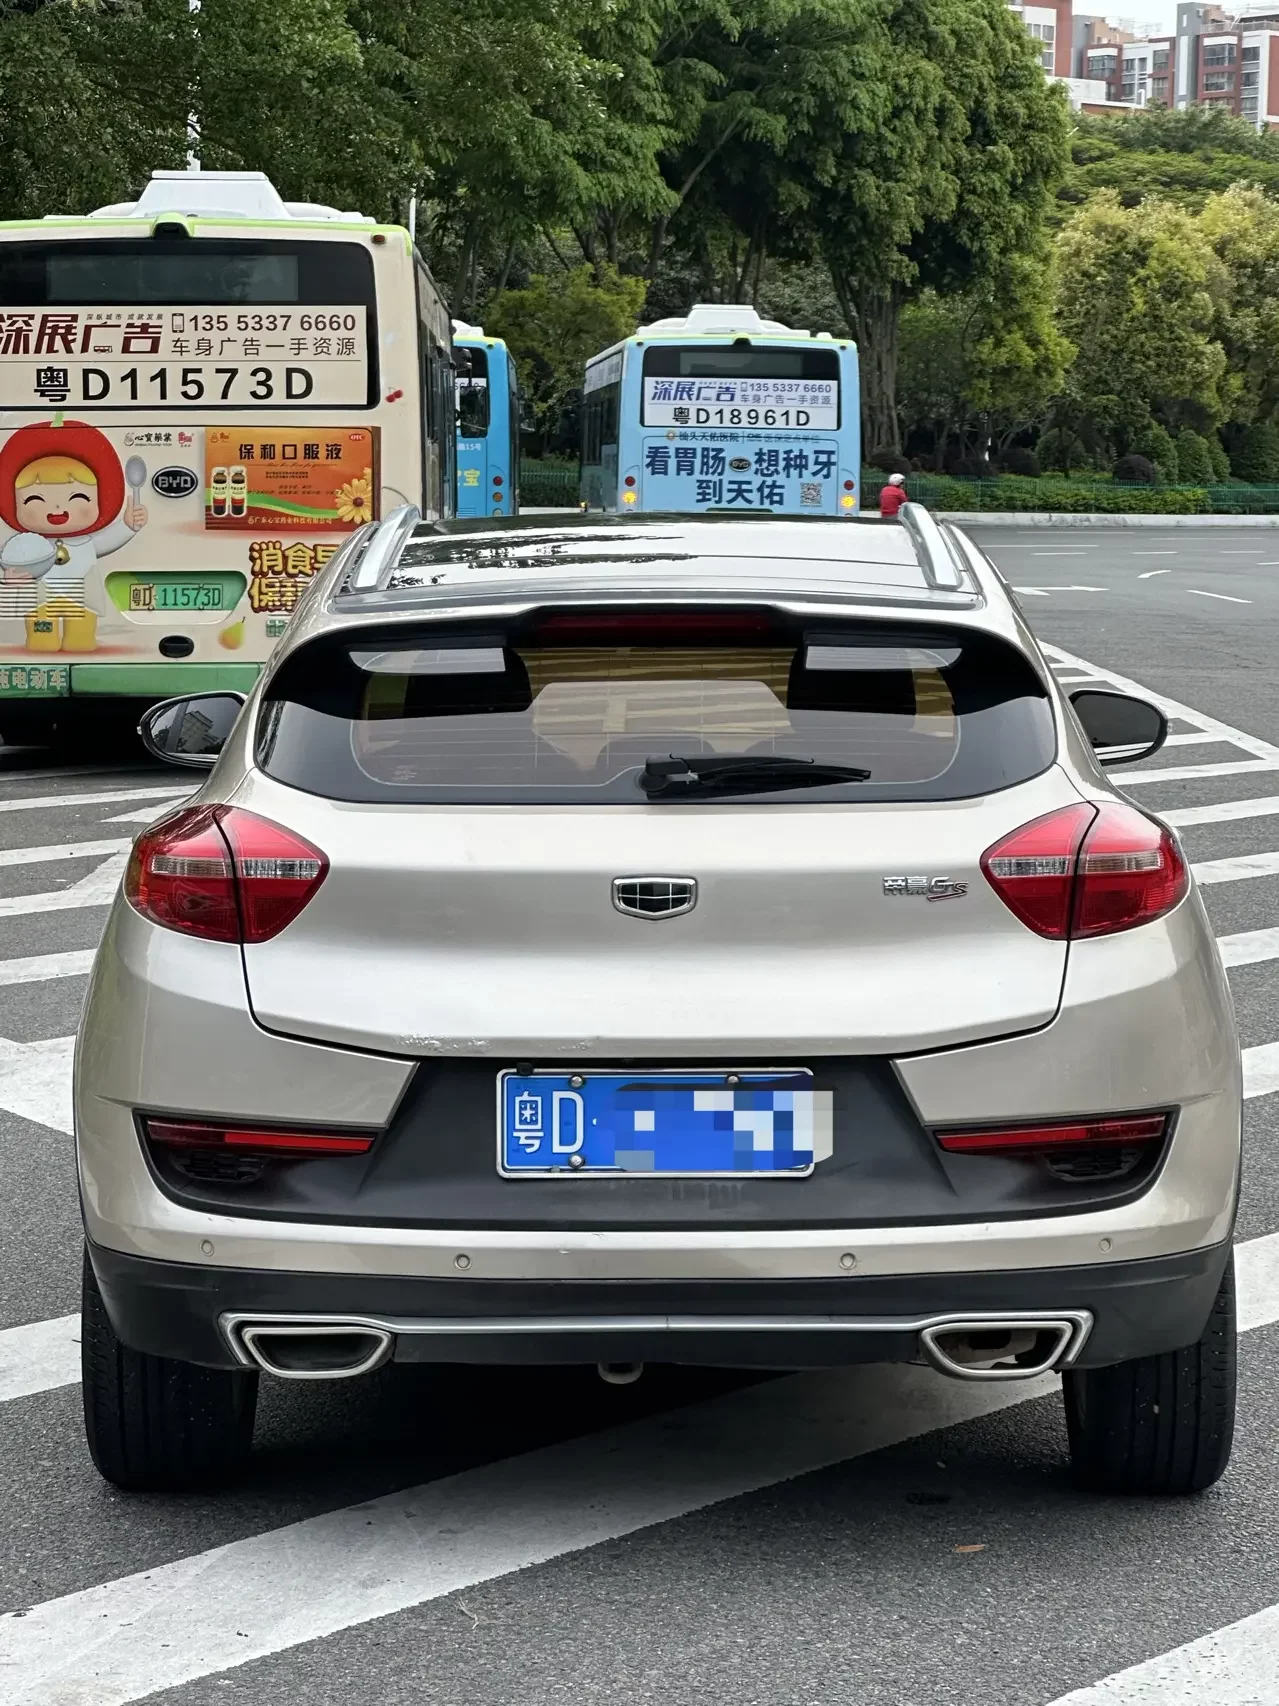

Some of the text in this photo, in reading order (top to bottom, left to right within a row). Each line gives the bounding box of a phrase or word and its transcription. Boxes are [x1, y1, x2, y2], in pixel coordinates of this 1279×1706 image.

[190, 314, 357, 332] 135 5337 6660
[171, 337, 357, 356] 车身广告一手资源
[34, 366, 314, 403] 粤D11573D
[651, 380, 738, 402] 深展广告
[750, 382, 832, 394] 135 5337 6660
[740, 394, 832, 405] 车身广告一手资源
[672, 406, 811, 427] 粤D18961D
[238, 443, 342, 460] 保和口服液
[645, 446, 837, 479] 看胃肠 想种牙
[158, 476, 191, 487] BYD
[695, 479, 785, 506] 到天佑
